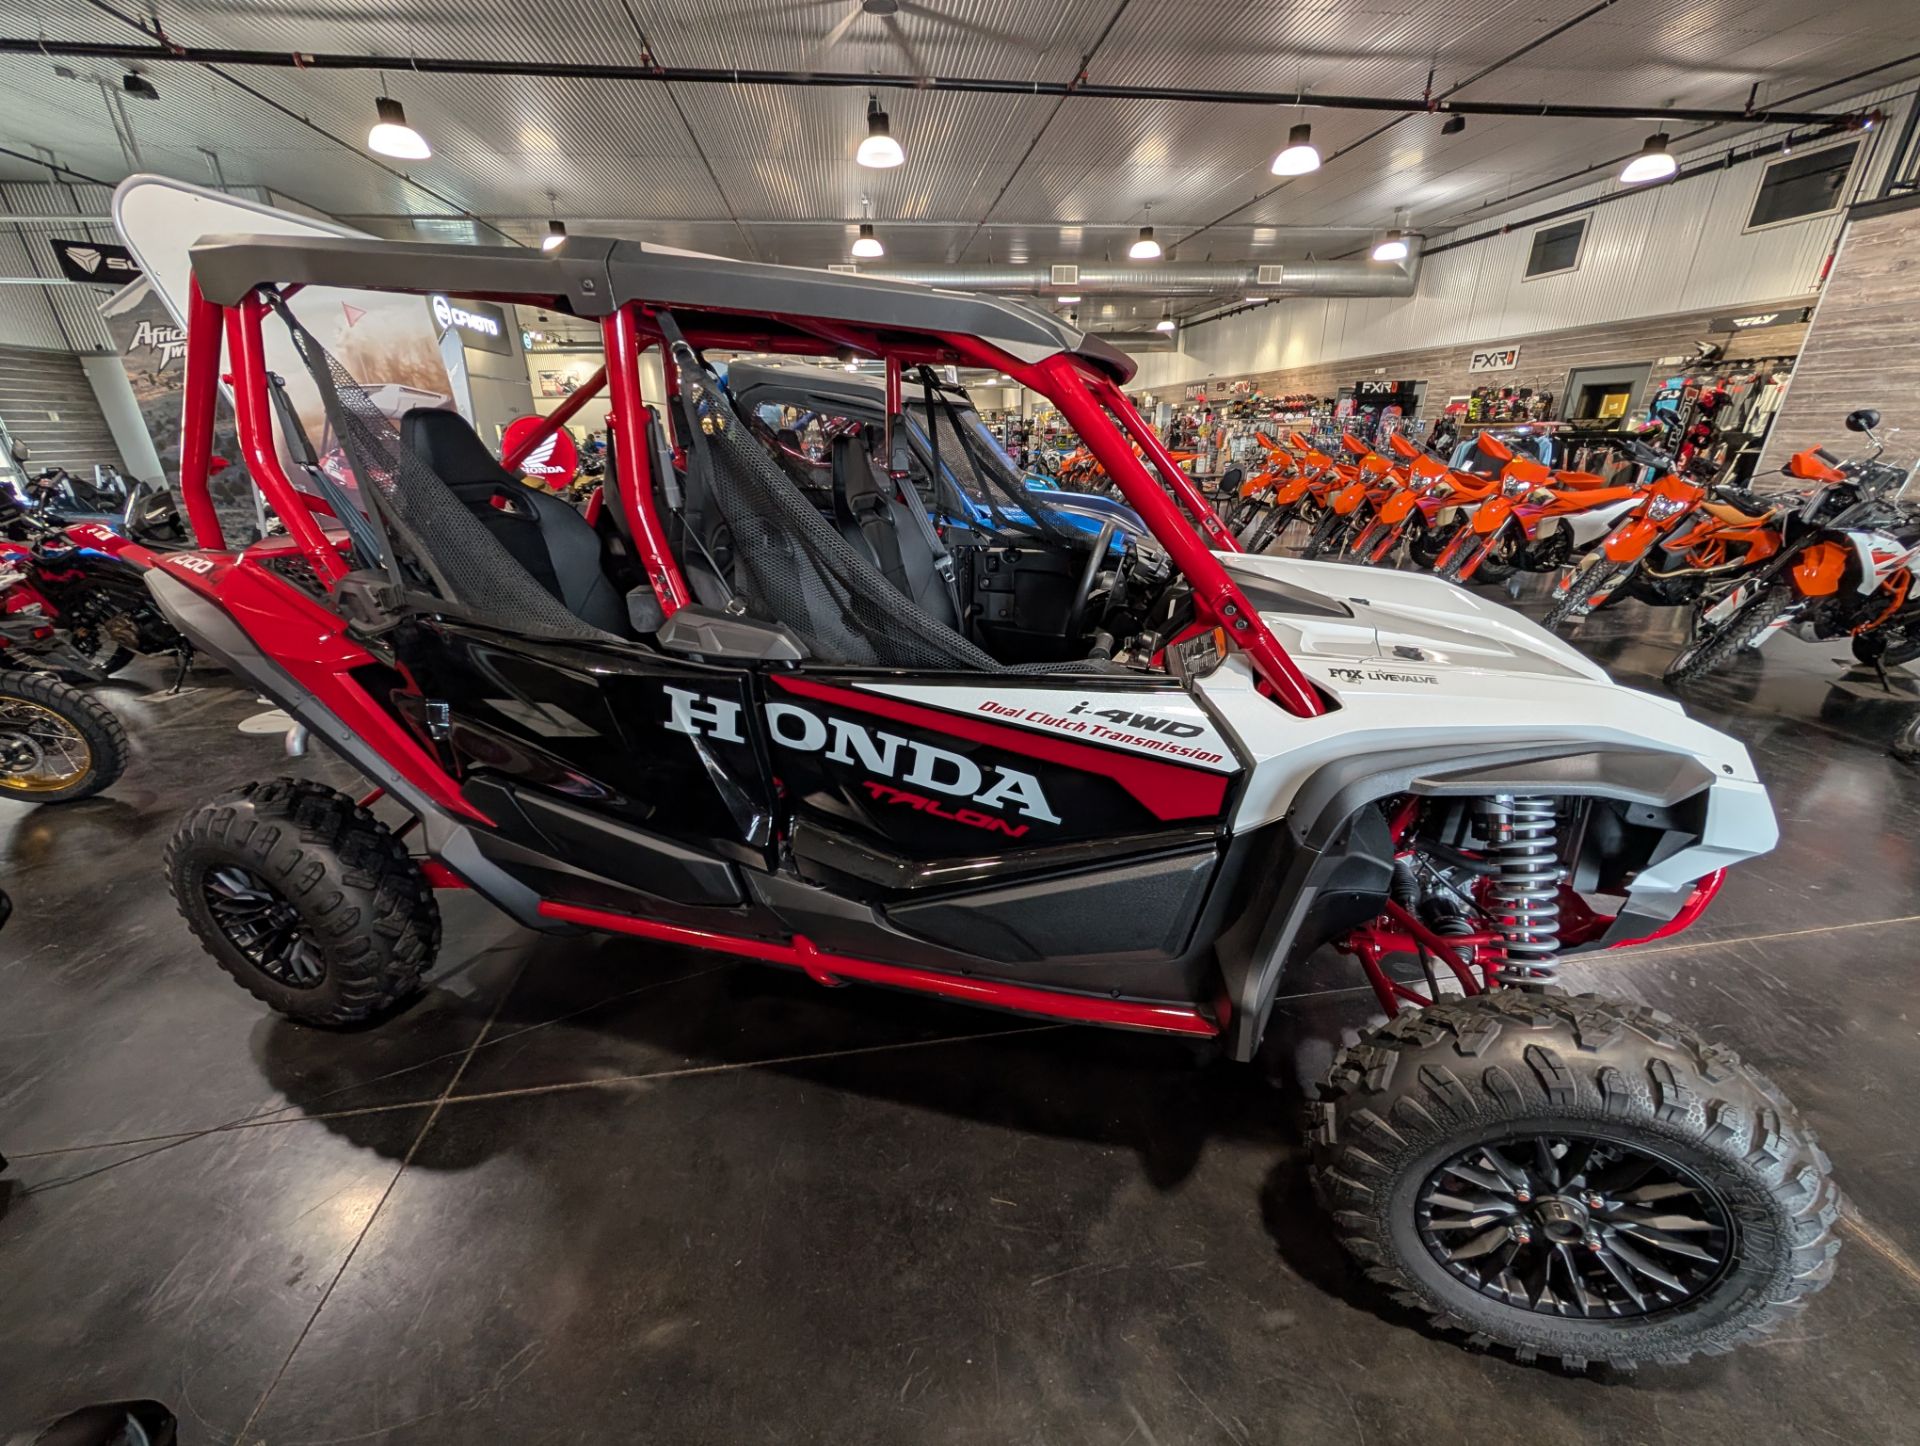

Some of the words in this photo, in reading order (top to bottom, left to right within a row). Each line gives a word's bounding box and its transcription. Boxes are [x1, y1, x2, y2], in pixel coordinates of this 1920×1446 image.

[1471, 351, 1508, 369] FXR
[1361, 381, 1393, 394] FXR
[520, 465, 566, 475] HONDA
[1328, 667, 1364, 682] FOX
[978, 700, 1026, 718] Dual
[1025, 711, 1088, 733] Clutch
[1089, 724, 1224, 764] Transmission
[1067, 701, 1205, 739] i-4WD
[662, 684, 1062, 825] HONDA
[861, 780, 1030, 838] TALON
